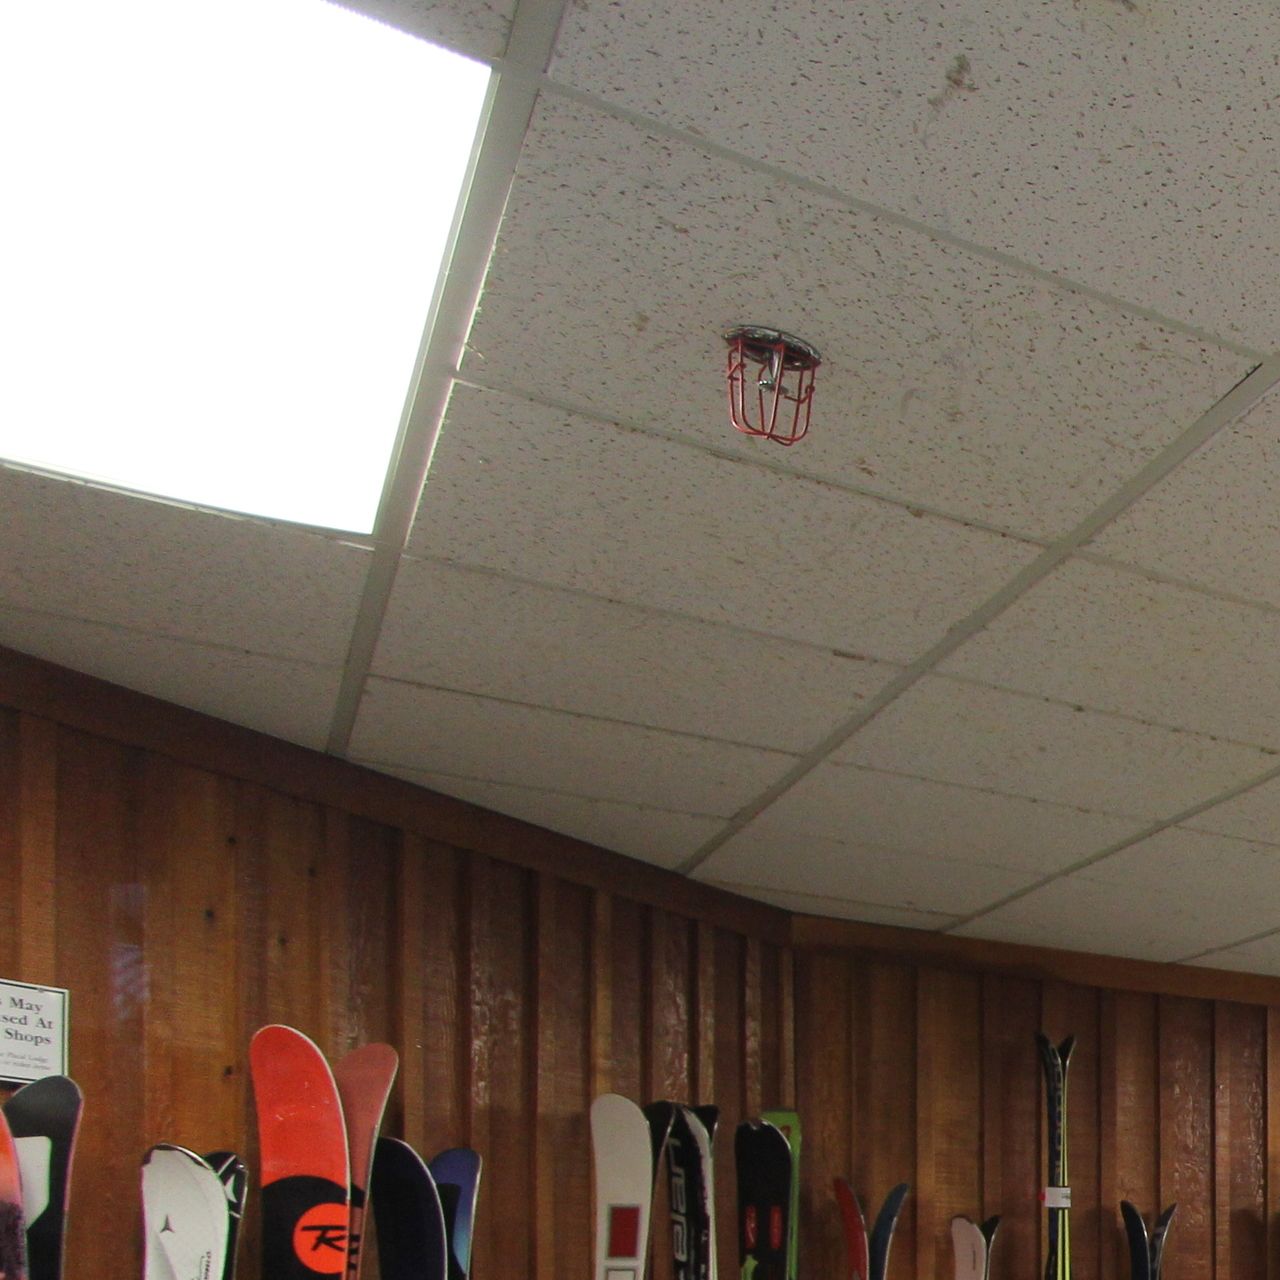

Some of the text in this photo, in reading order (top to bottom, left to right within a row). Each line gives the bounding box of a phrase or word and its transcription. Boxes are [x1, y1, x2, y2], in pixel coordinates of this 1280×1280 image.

[10, 996, 43, 1014] May
[36, 1017, 54, 1029] At
[4, 1028, 52, 1046] Shops
